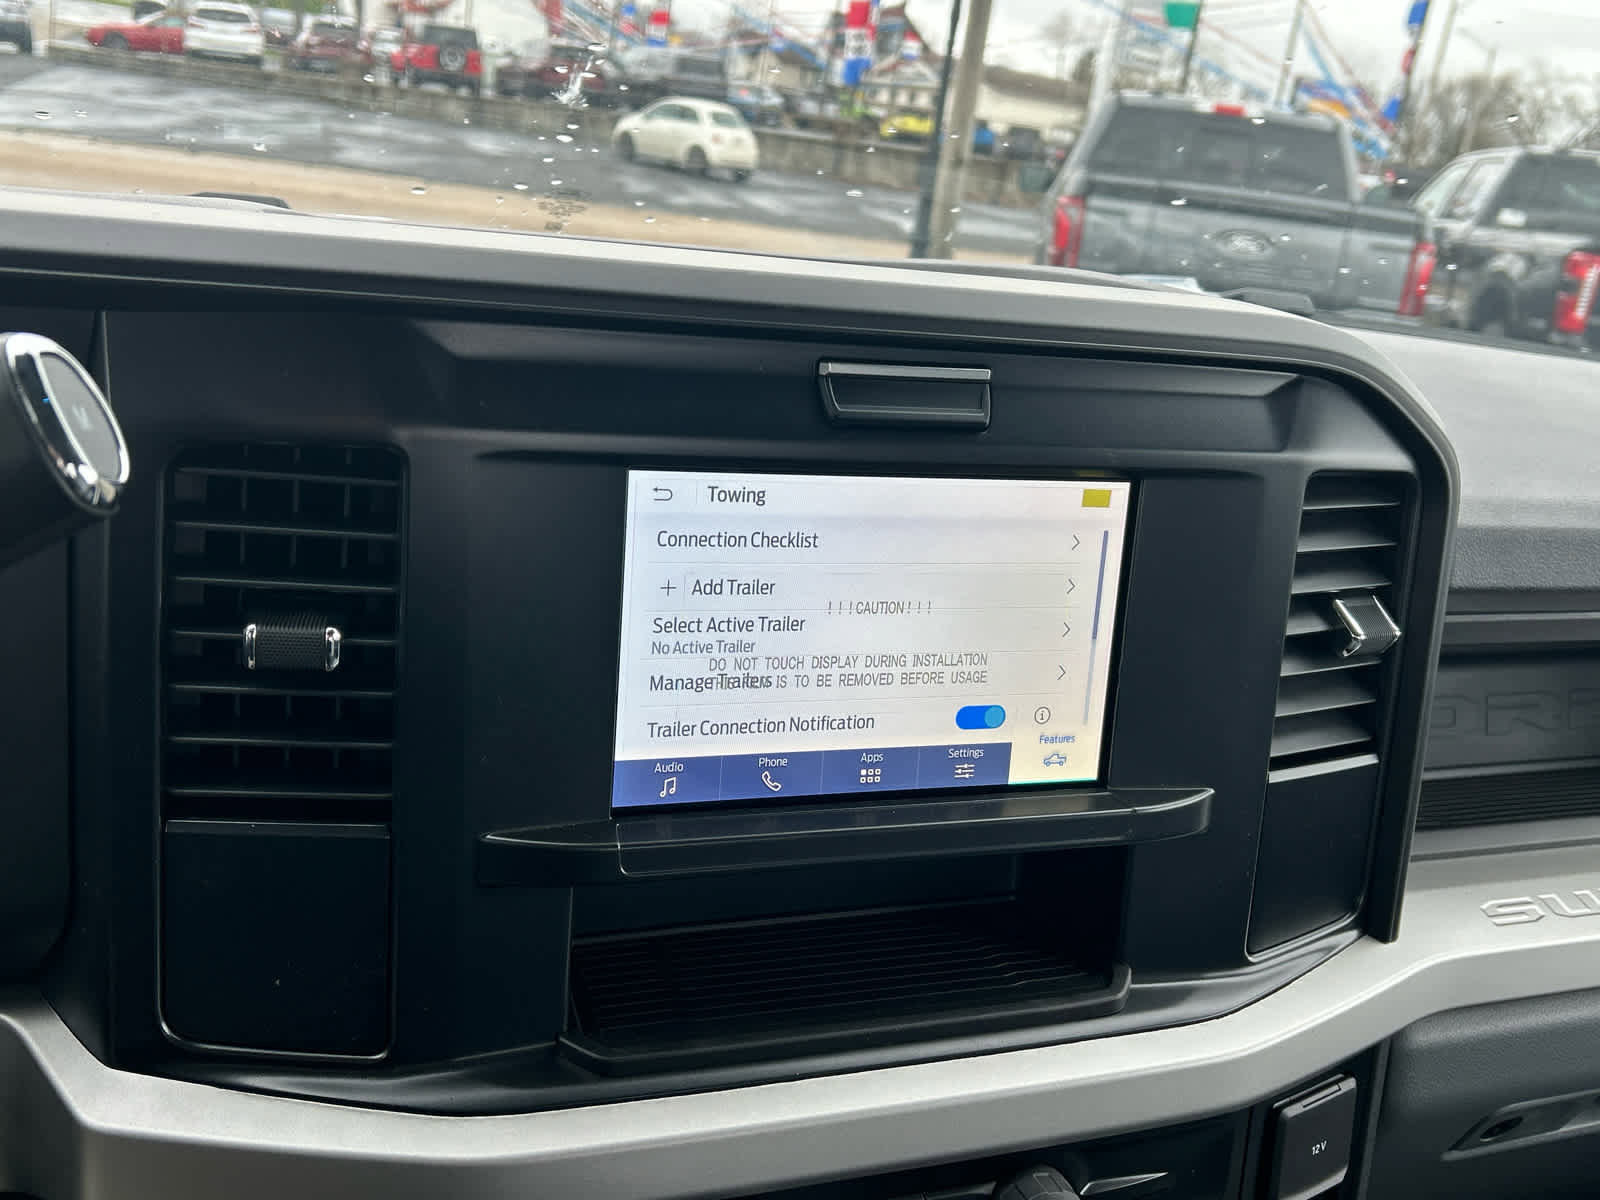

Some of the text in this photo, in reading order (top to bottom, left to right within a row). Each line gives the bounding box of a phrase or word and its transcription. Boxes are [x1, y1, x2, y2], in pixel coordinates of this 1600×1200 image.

[707, 485, 766, 506] Towing
[657, 530, 819, 549] Connection Checklist
[691, 578, 776, 595] Add Trailer
[653, 615, 806, 634] Select Active Trailer
[651, 639, 756, 655] No Active Trailer
[709, 653, 988, 672] DO NOT TOUCH DISPLAY DURING INSTALLATION
[649, 671, 773, 693] Manage Trailers
[776, 674, 788, 689] IS
[794, 673, 810, 688] TO
[816, 673, 832, 687] BE
[838, 672, 894, 687] REMOVED
[900, 672, 945, 686] BEFORE
[950, 670, 988, 685] USAGE
[647, 714, 875, 738] Trailer Connection Notification
[1038, 734, 1076, 745] Features
[758, 756, 788, 768] Phone
[861, 753, 884, 763] Apps
[948, 748, 984, 760] Settings
[654, 761, 684, 774] Audio
[1479, 889, 1600, 927] SU
